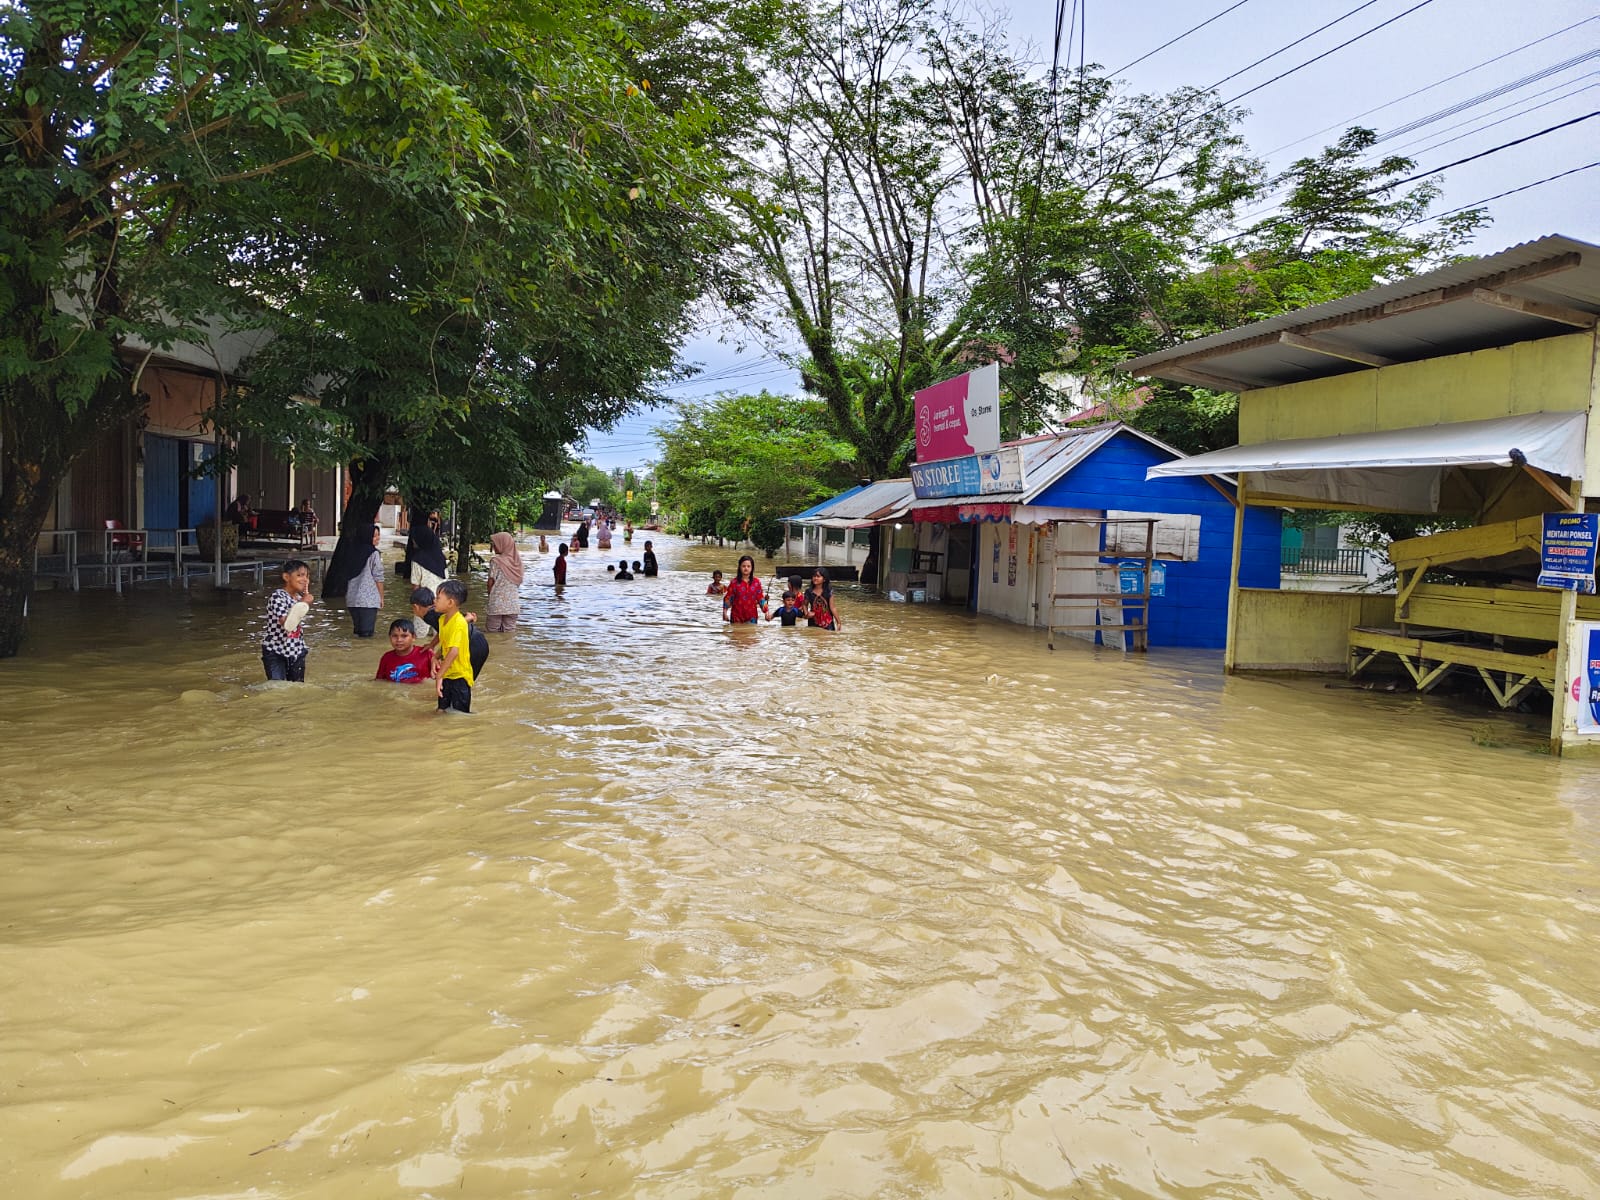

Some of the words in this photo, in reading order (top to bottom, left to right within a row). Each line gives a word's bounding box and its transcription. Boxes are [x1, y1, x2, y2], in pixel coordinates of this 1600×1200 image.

[913, 471, 924, 488] OS
[925, 464, 960, 486] STOREE
[1546, 530, 1569, 538] MENTARI
[1570, 531, 1592, 539] PONSEL
